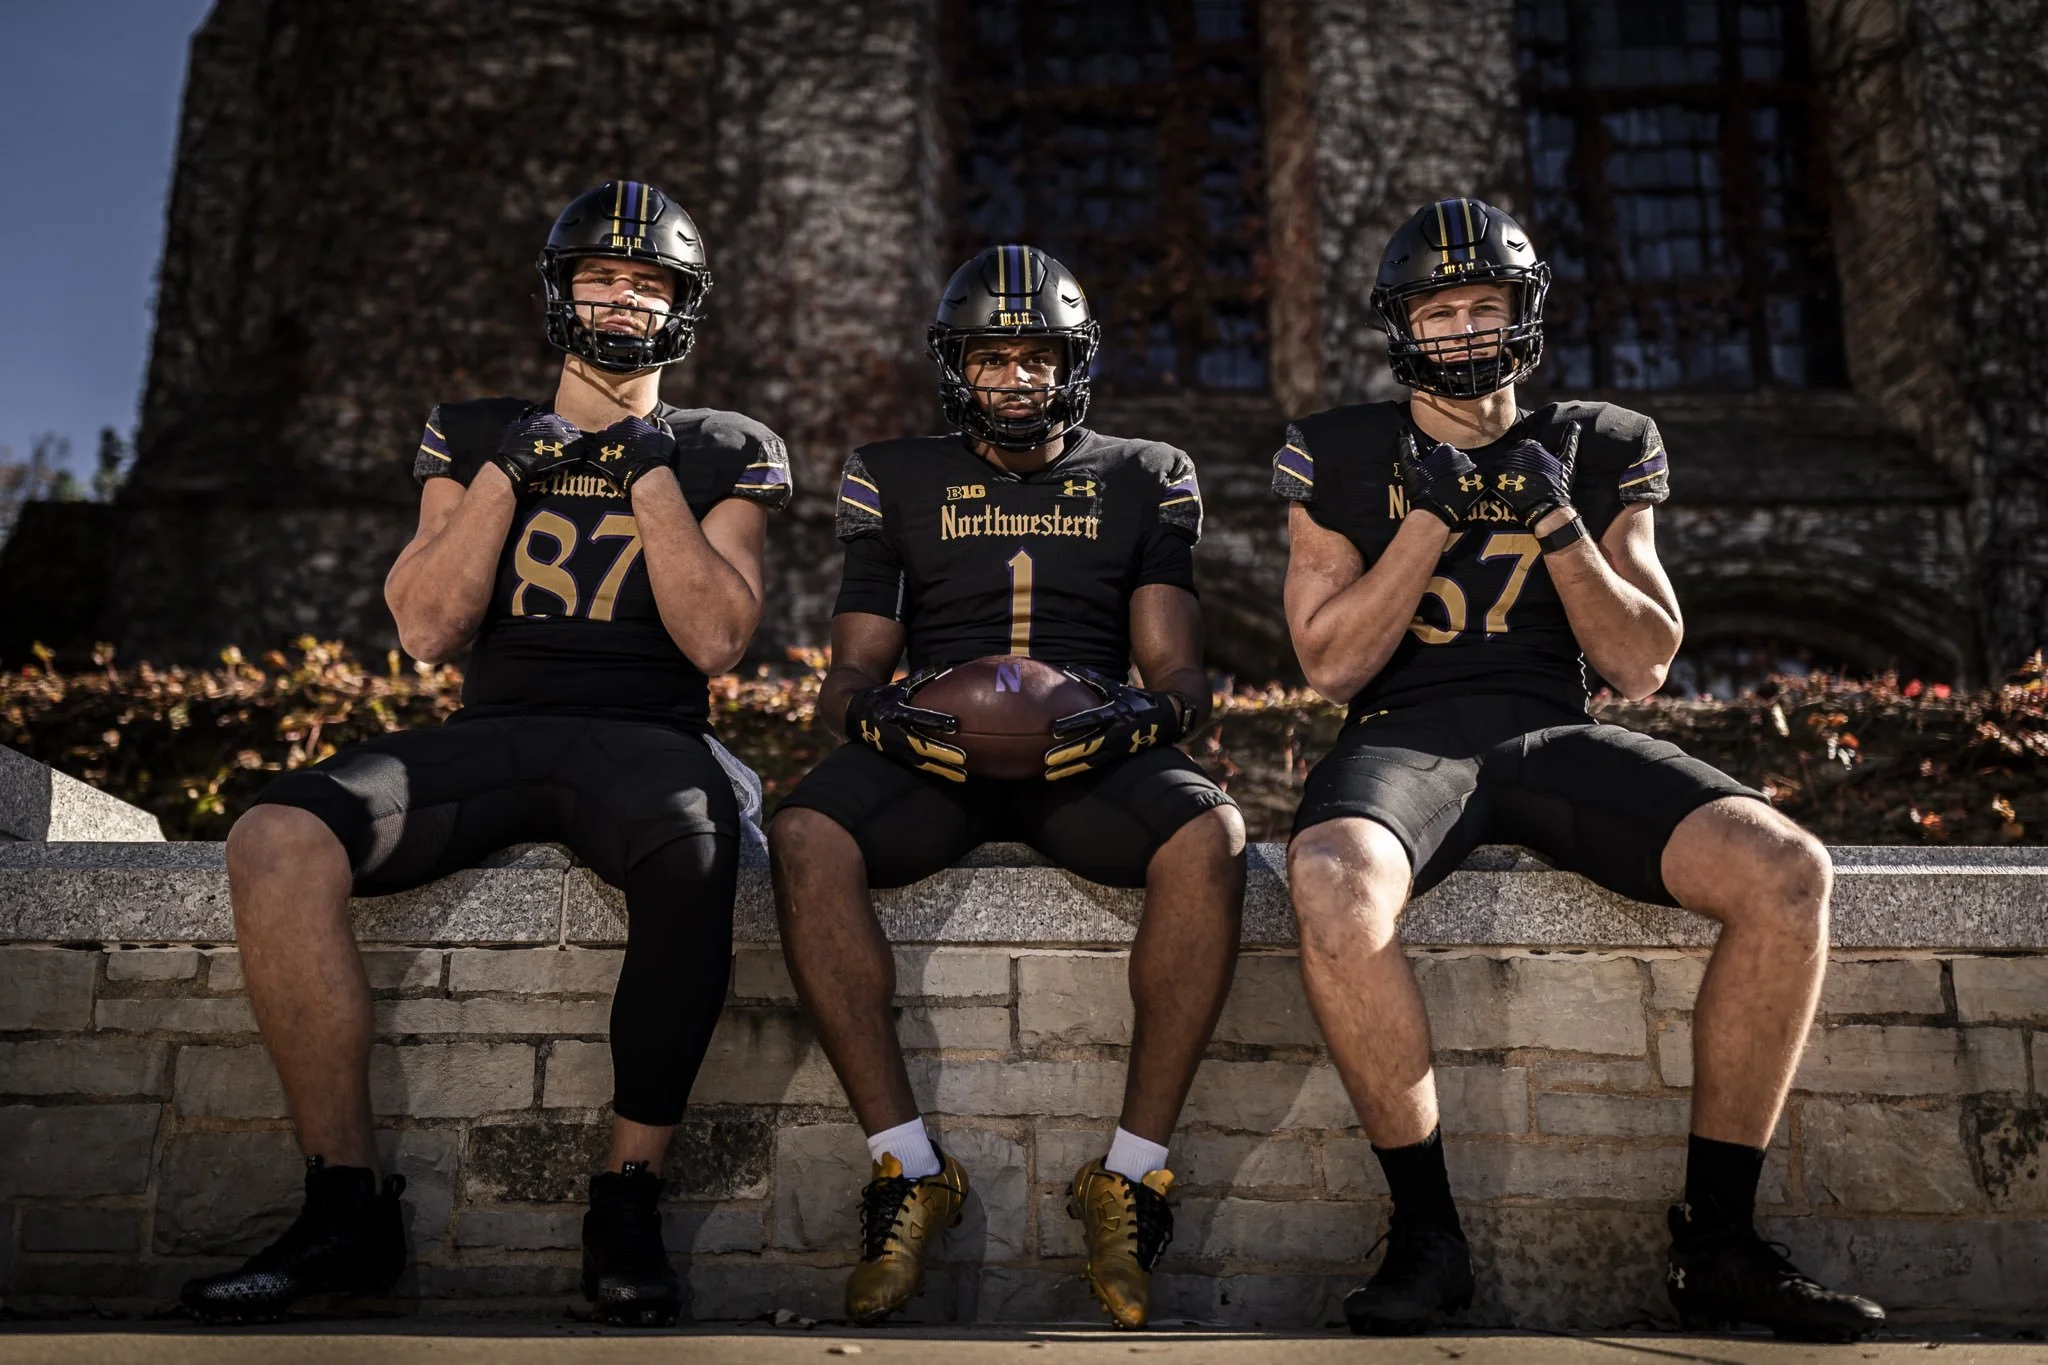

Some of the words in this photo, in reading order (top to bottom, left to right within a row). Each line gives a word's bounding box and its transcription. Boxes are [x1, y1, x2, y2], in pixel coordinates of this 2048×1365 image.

[941, 504, 1101, 541] Northwestern
[510, 508, 645, 622] 87
[1006, 547, 1033, 658] 1
[995, 663, 1022, 692] N
